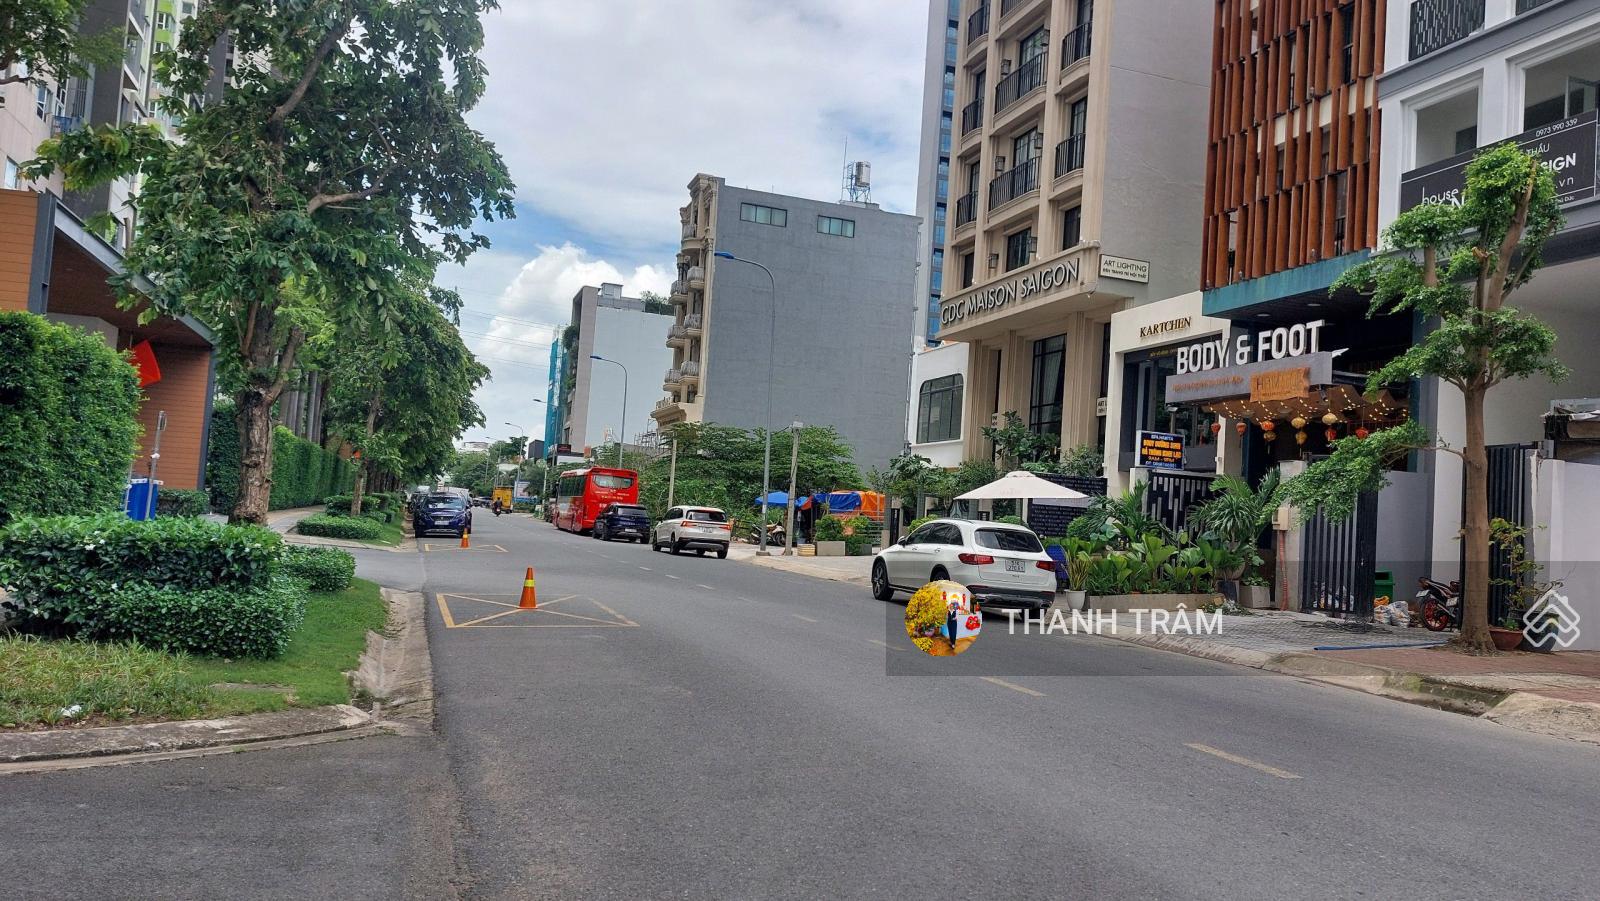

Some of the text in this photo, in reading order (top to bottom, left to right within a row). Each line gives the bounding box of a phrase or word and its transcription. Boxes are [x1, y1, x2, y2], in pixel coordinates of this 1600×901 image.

[1535, 118, 1578, 137] 0973 990 339
[1116, 262, 1147, 272] LIGHTING
[940, 258, 1080, 327] CDC MAISON SAIGON
[1139, 316, 1192, 337] KARTCHEN
[1176, 319, 1325, 375] BODY & FOOT
